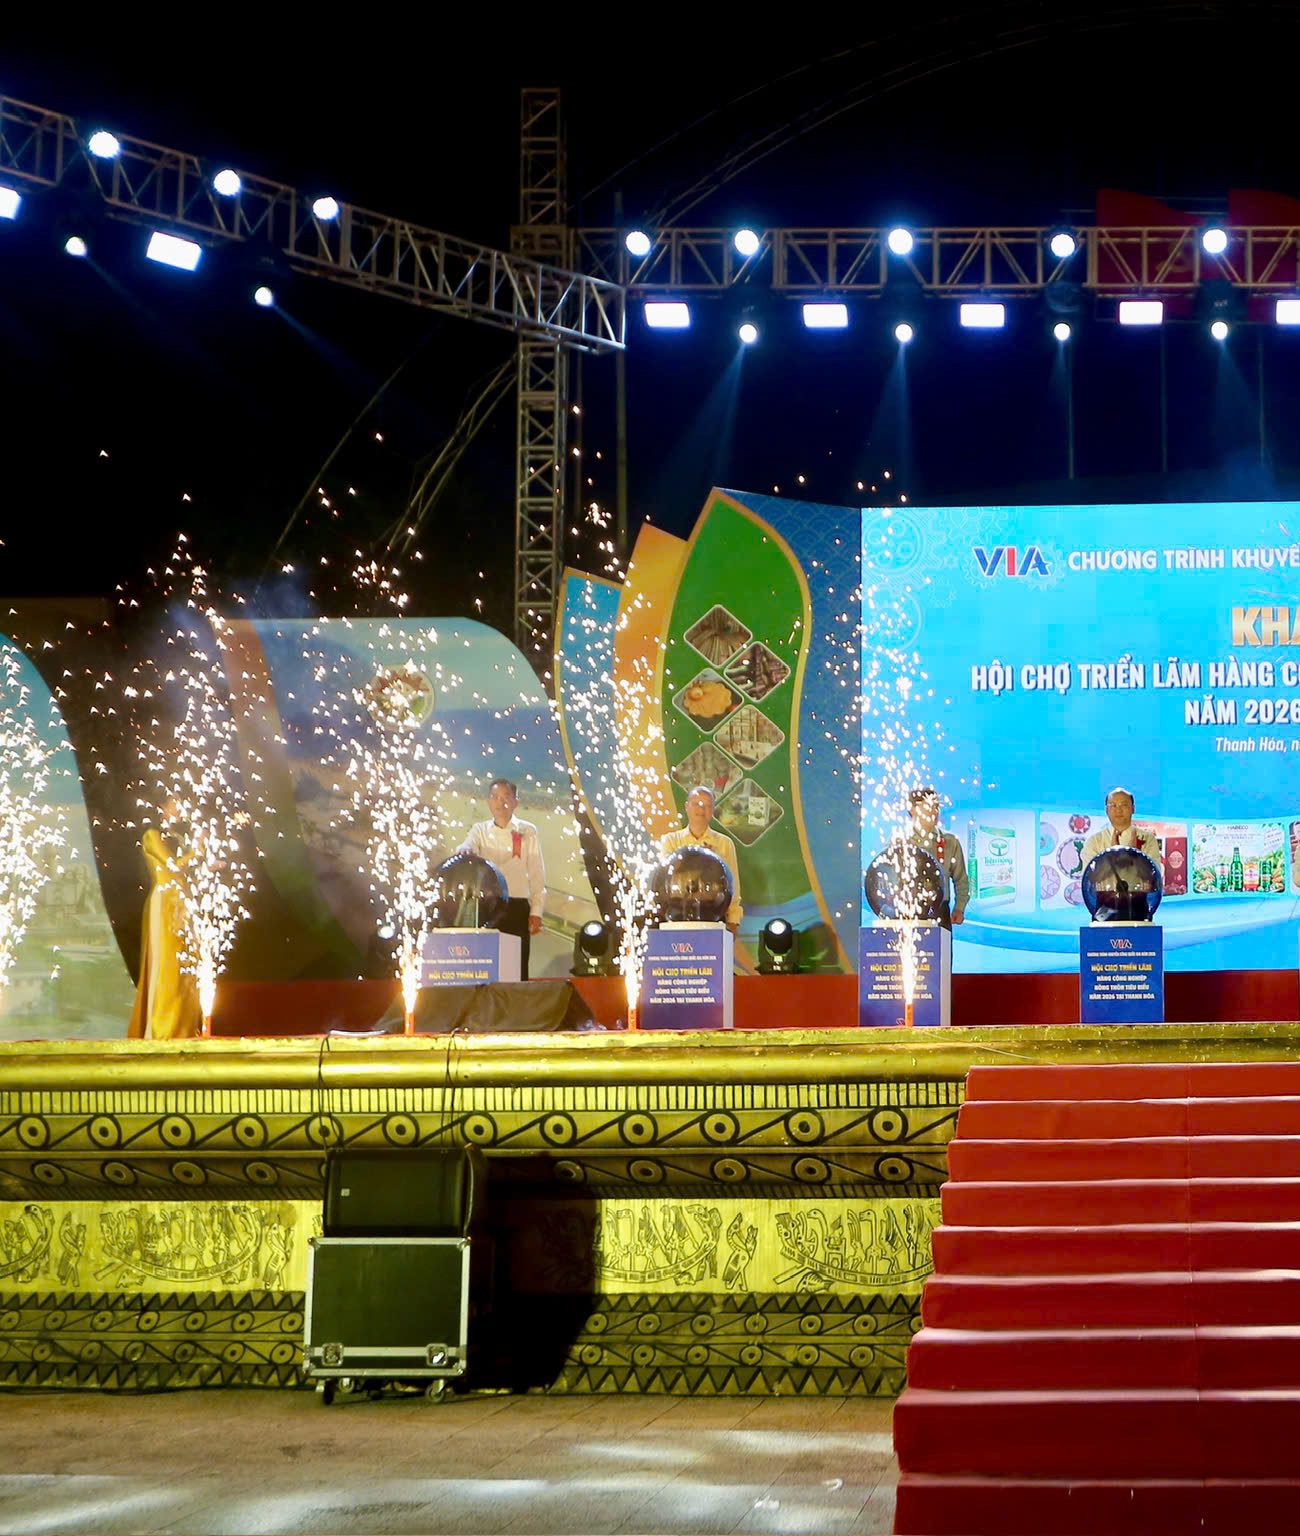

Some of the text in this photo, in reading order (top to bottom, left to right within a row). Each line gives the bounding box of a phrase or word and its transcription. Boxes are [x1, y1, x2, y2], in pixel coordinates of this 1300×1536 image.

[973, 546, 1051, 576] VIA
[1068, 550, 1157, 570] CHƯƠNG
[1163, 546, 1224, 569] TRÌNH
[971, 659, 1014, 695] HỘI
[1020, 662, 1071, 694] CHỢ
[1078, 653, 1145, 690] TRIỂN
[1153, 656, 1201, 689] LÃM
[1208, 654, 1275, 688] HÀNG
[1184, 694, 1237, 726] NĂM
[1215, 737, 1255, 752] Thanh
[1259, 736, 1287, 754] Hóa,
[1110, 939, 1132, 948] VIA
